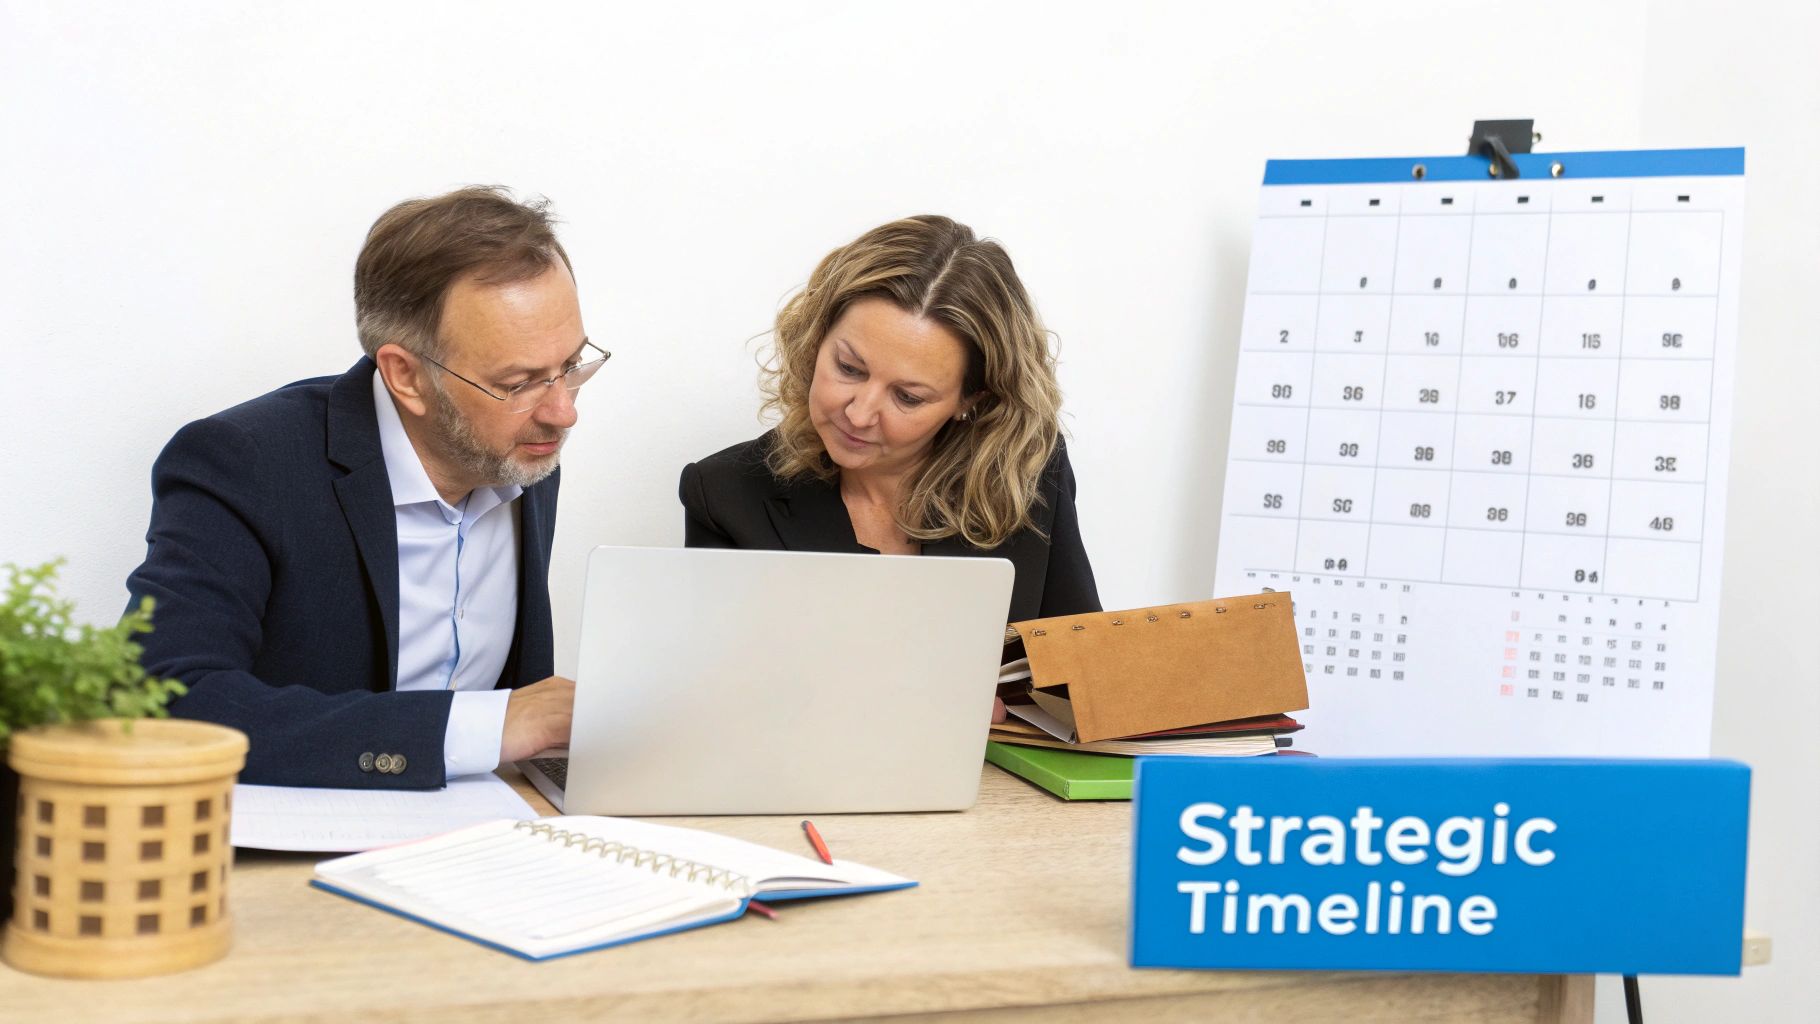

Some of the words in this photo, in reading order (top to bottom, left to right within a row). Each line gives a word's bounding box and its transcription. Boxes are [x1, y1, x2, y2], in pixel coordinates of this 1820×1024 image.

[1279, 329, 1289, 343] 2
[1495, 390, 1517, 405] 37
[1177, 802, 1557, 876] Strategic
[1177, 880, 1498, 935] Timeline
